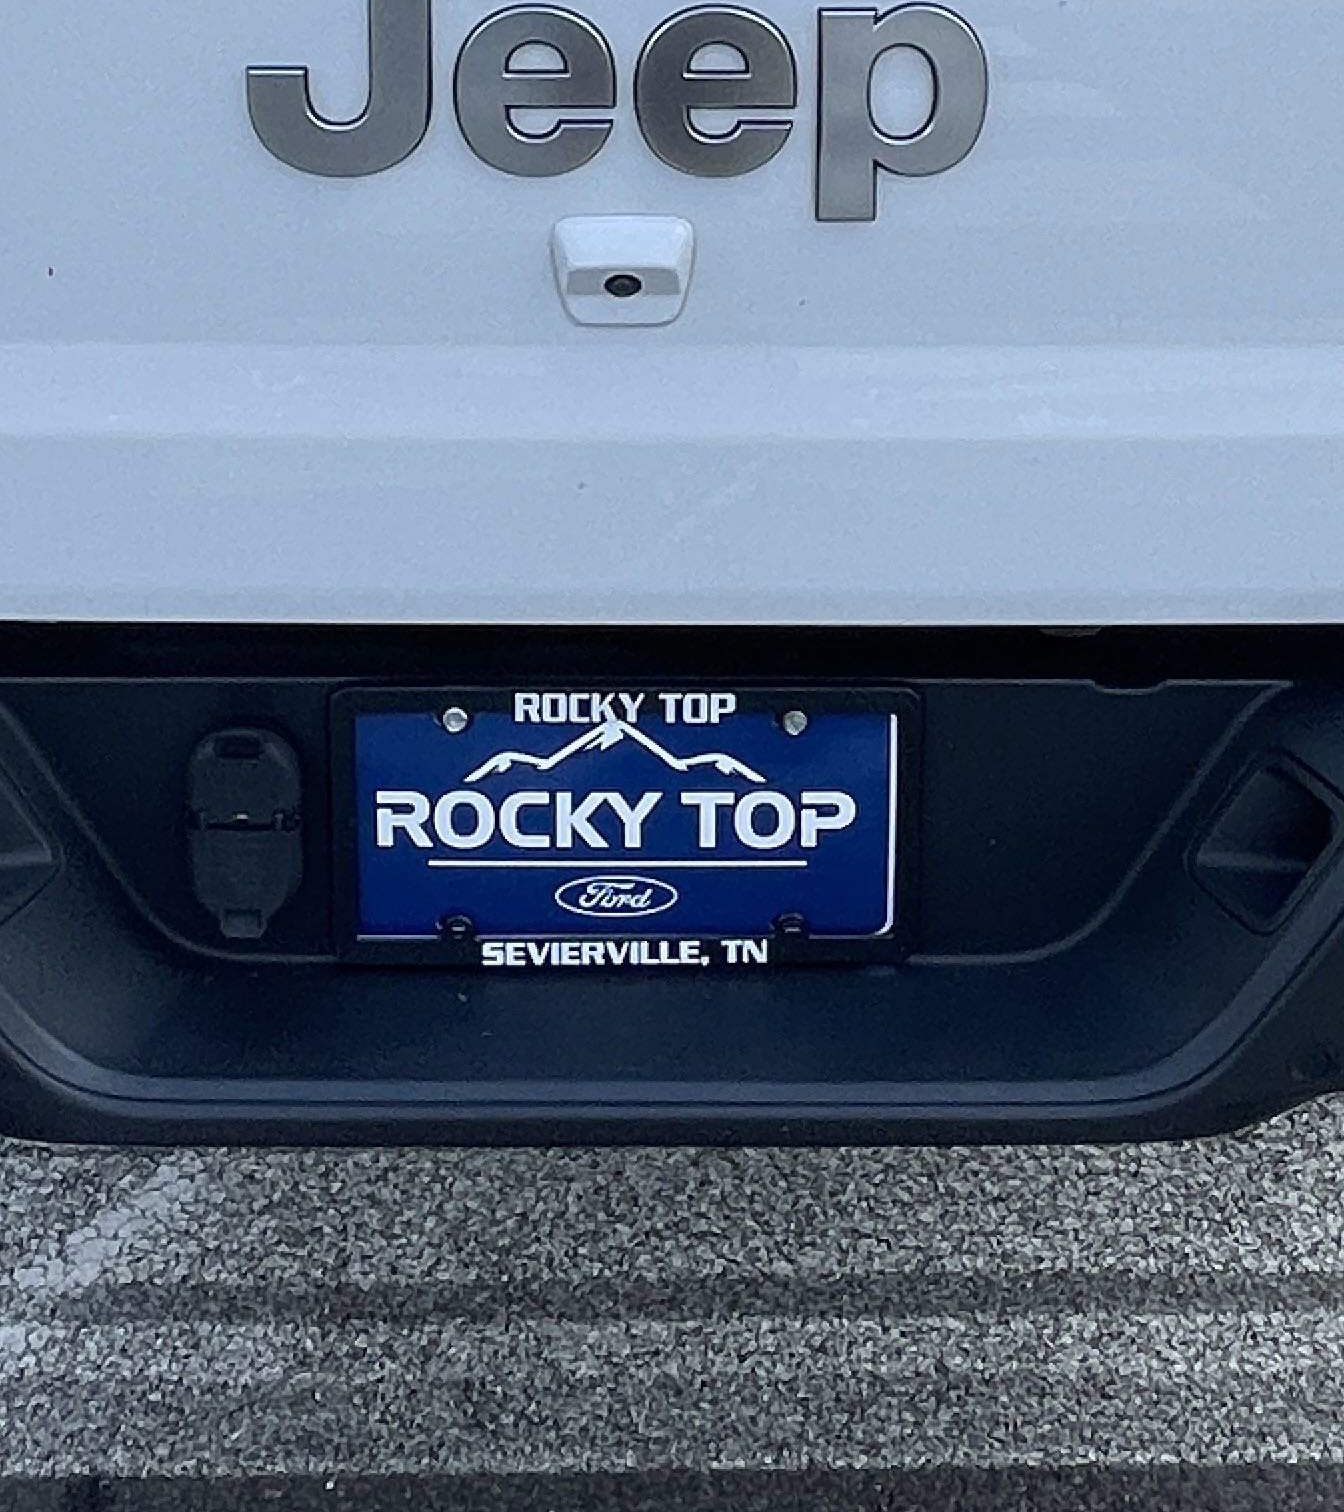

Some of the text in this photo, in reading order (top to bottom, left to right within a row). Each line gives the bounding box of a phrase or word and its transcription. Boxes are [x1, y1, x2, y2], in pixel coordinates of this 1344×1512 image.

[514, 692, 737, 724] ROCKY TOP
[375, 790, 856, 849] ROCKY TOP
[579, 882, 653, 908] Ford
[481, 938, 768, 968] SEVIERVILLE, TN
